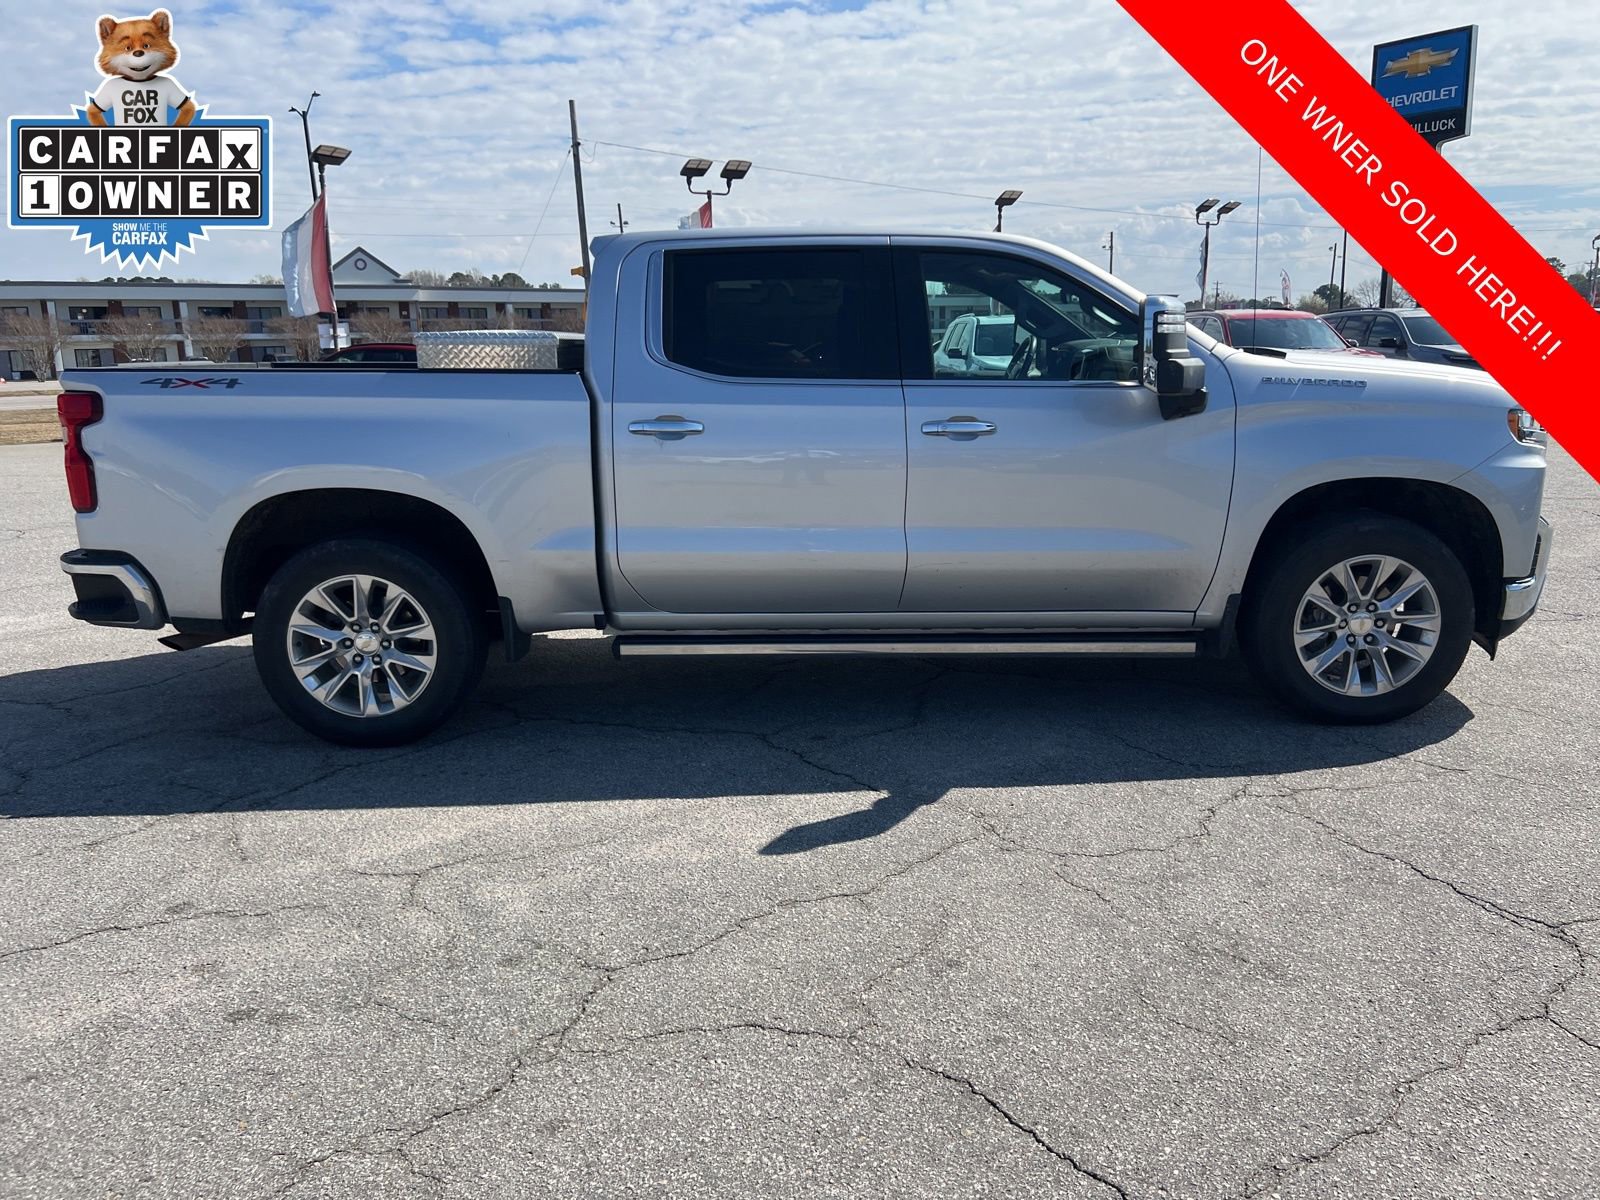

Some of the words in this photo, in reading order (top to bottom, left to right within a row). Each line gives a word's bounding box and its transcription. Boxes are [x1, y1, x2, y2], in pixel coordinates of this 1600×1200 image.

[1385, 86, 1459, 107] HEVROLET
[1410, 118, 1457, 134] LLUCK
[1261, 376, 1368, 389] SILVERADO
